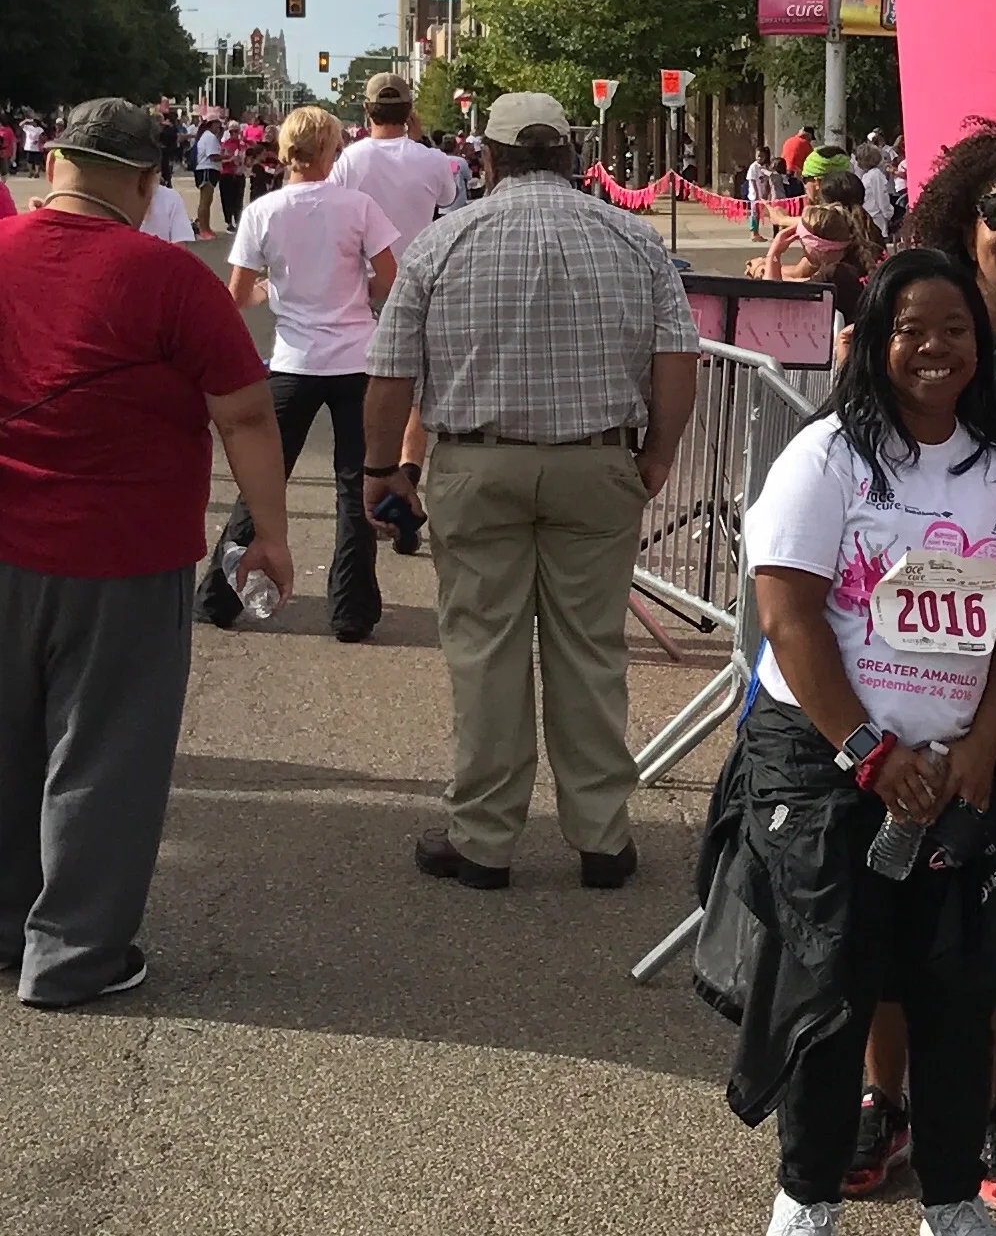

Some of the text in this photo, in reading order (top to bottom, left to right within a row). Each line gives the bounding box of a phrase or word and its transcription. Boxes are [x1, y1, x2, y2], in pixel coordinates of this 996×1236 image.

[786, 4, 824, 17] cure
[875, 502, 902, 511] cure
[896, 588, 987, 638] 2016
[857, 658, 978, 687] GREATER AMARILLO
[858, 674, 928, 695] September
[929, 685, 947, 699] 24,
